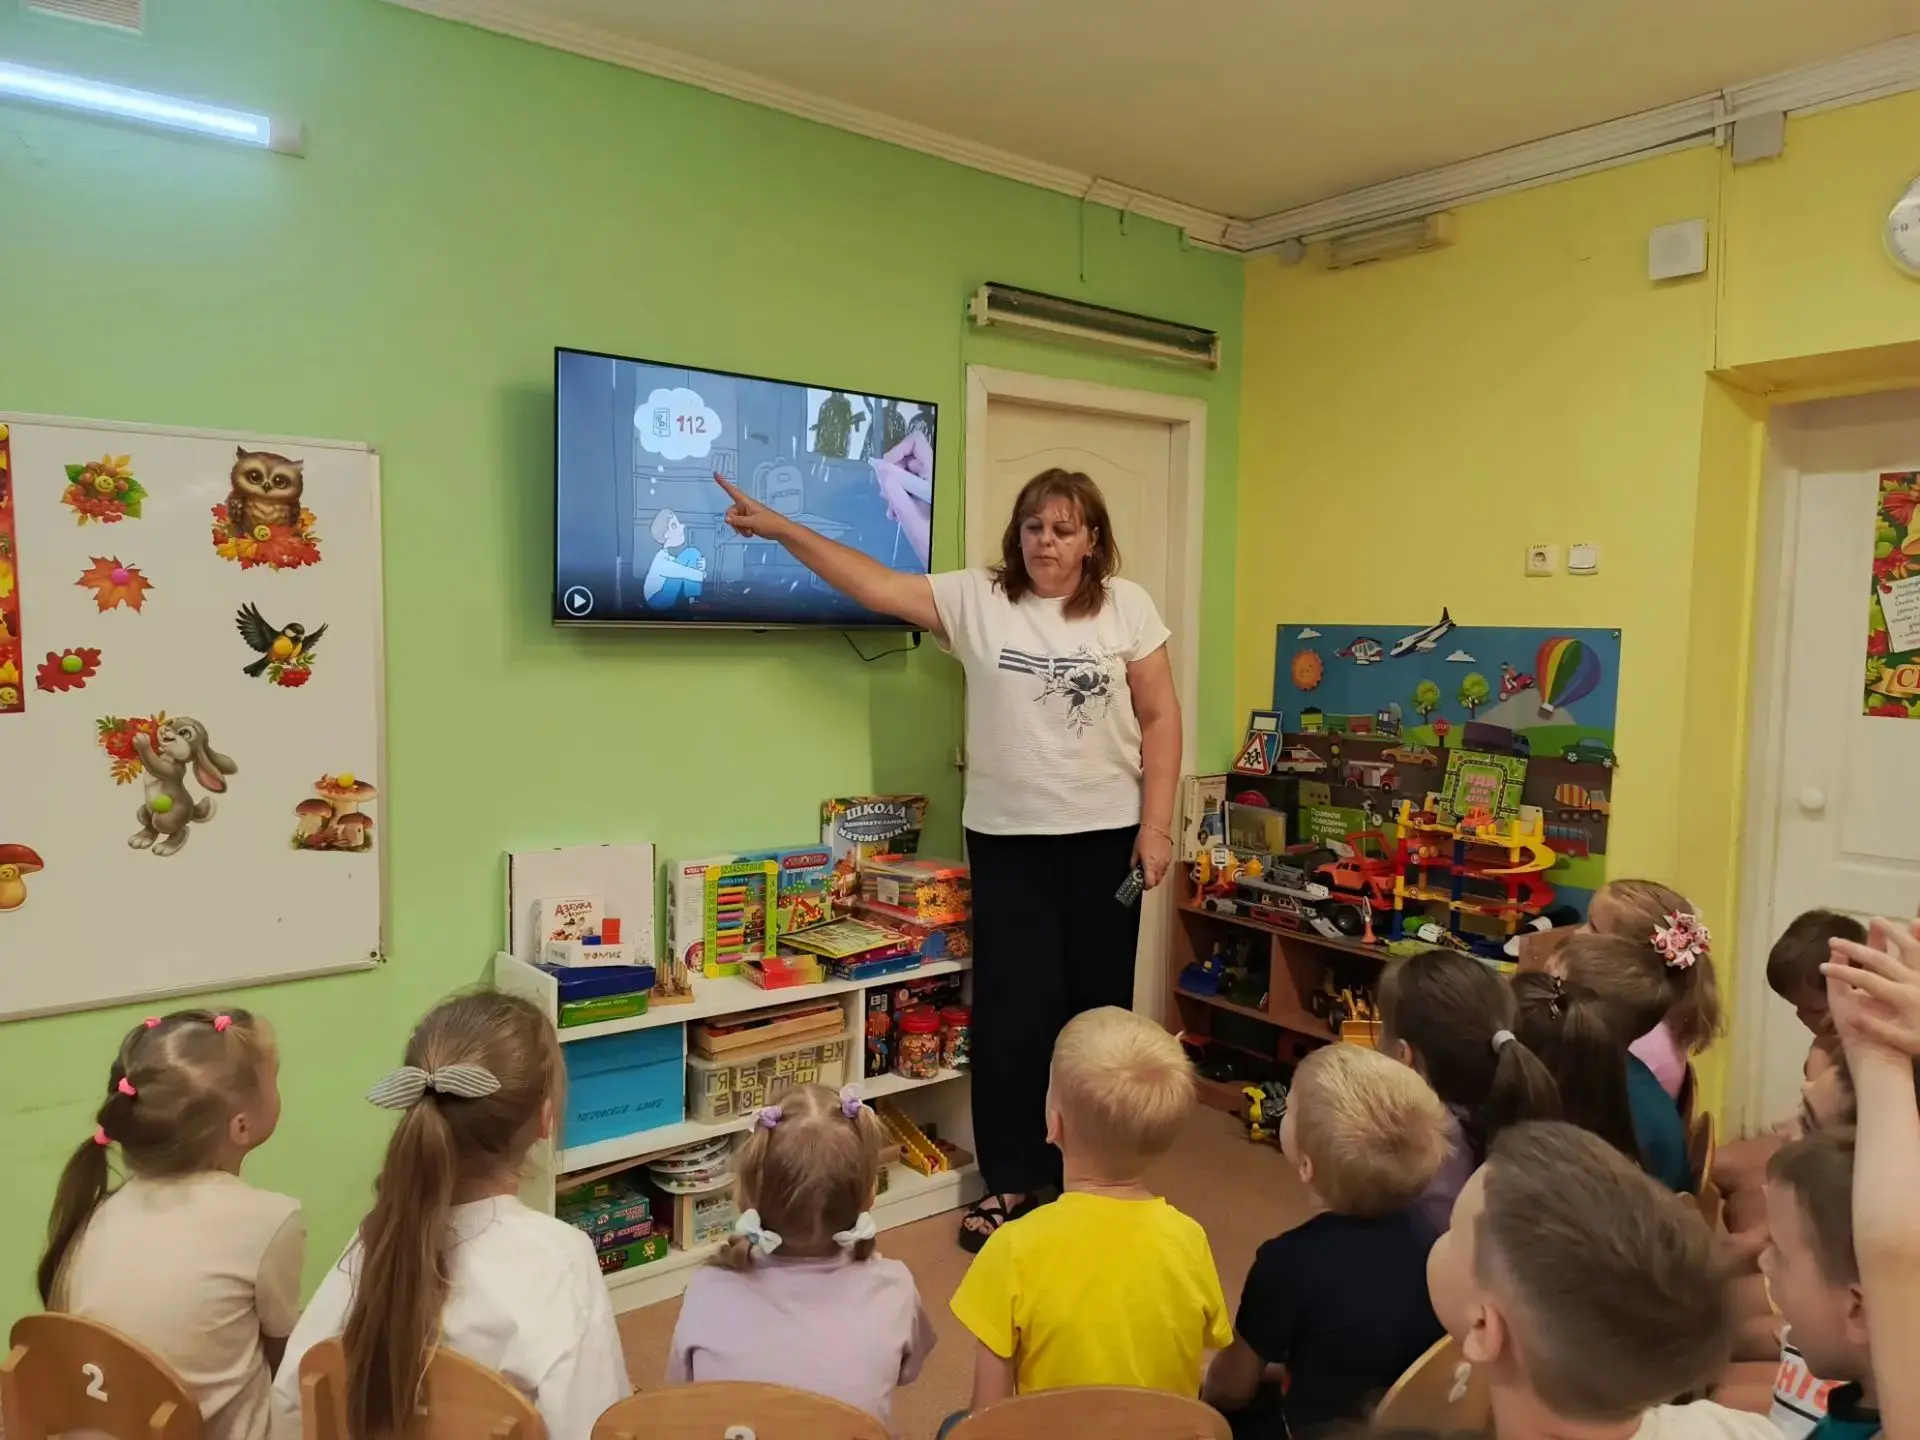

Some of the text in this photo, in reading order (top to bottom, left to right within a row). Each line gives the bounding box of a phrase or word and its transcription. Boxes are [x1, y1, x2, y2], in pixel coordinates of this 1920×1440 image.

[676, 415, 707, 435] 112
[845, 803, 906, 821] ШКОЛА
[554, 901, 593, 917] АЗБУКА
[82, 1363, 108, 1402] 2
[1448, 1362, 1472, 1403] 2
